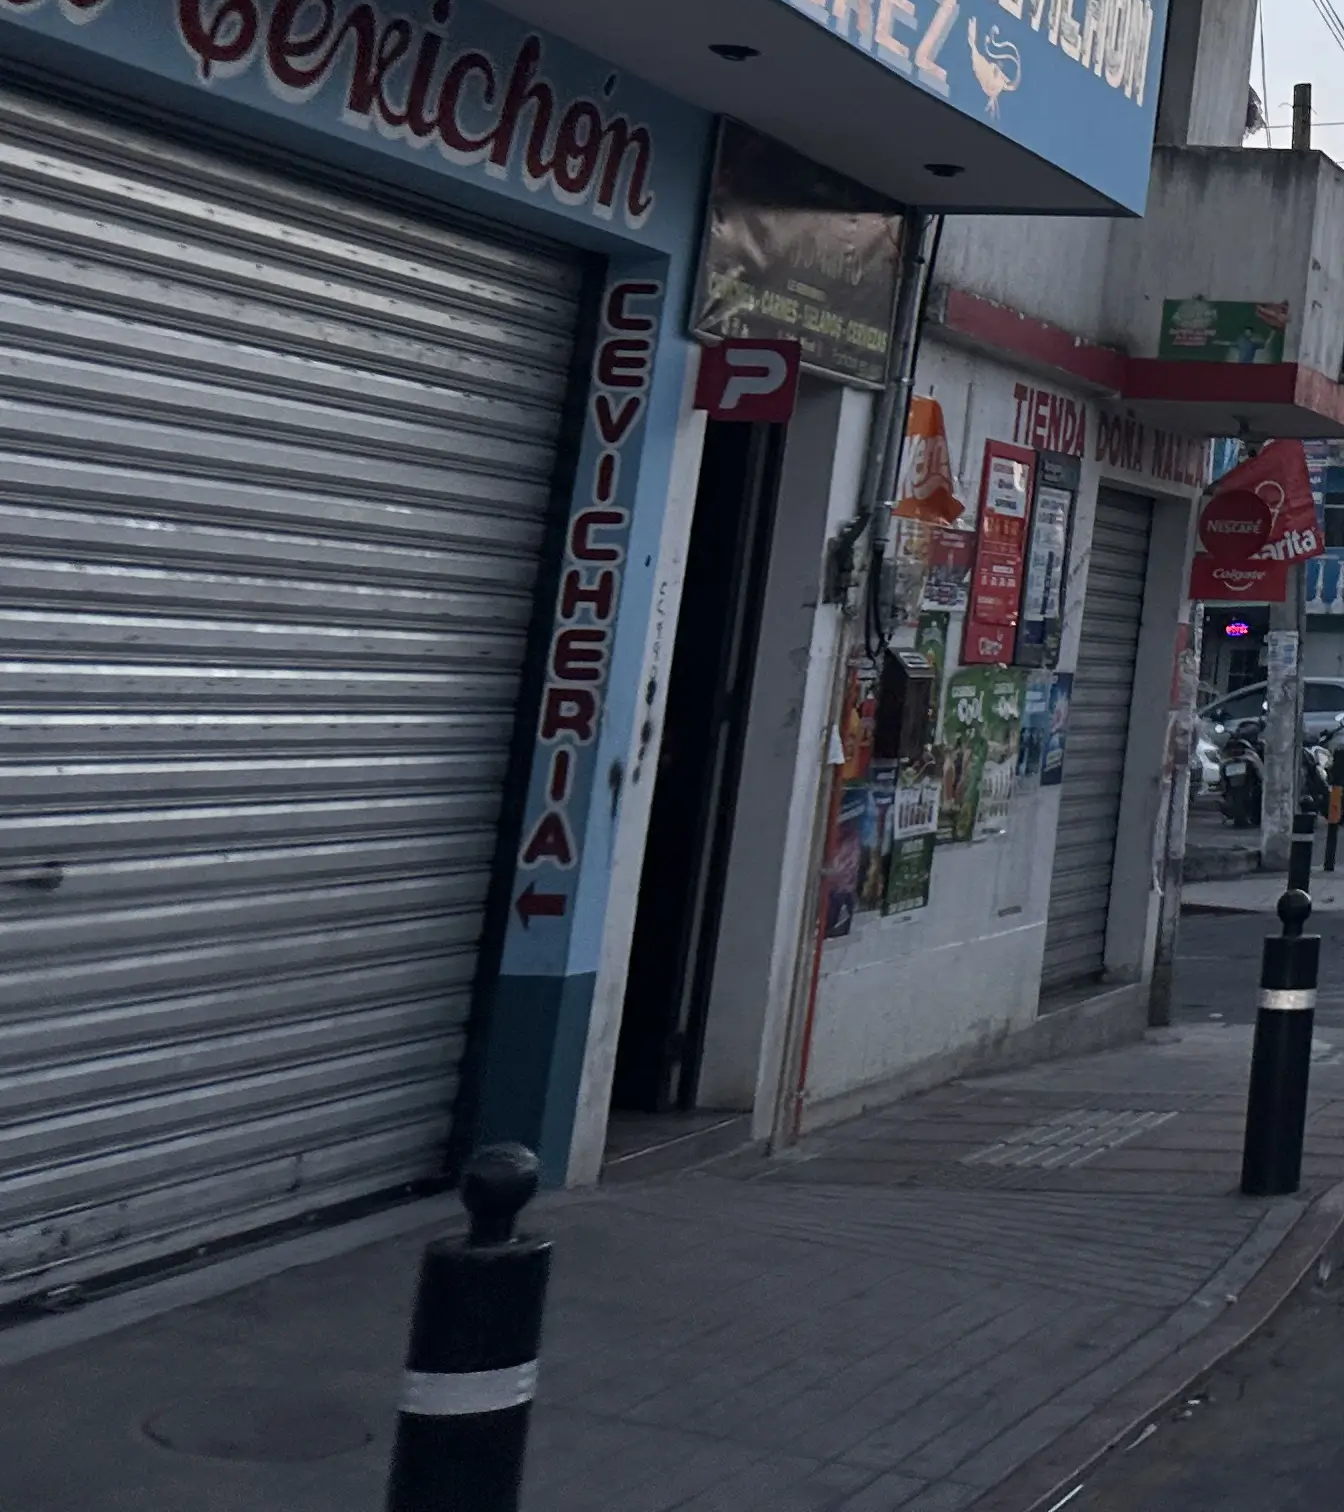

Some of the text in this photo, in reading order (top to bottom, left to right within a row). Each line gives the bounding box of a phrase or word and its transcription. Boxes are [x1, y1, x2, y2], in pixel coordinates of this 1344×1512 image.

[1012, 382, 1087, 458] TIENDA
[1095, 408, 1145, 472] DOÑA
[524, 282, 661, 867] CEVICHERIA
[1212, 567, 1266, 582] Colgate
